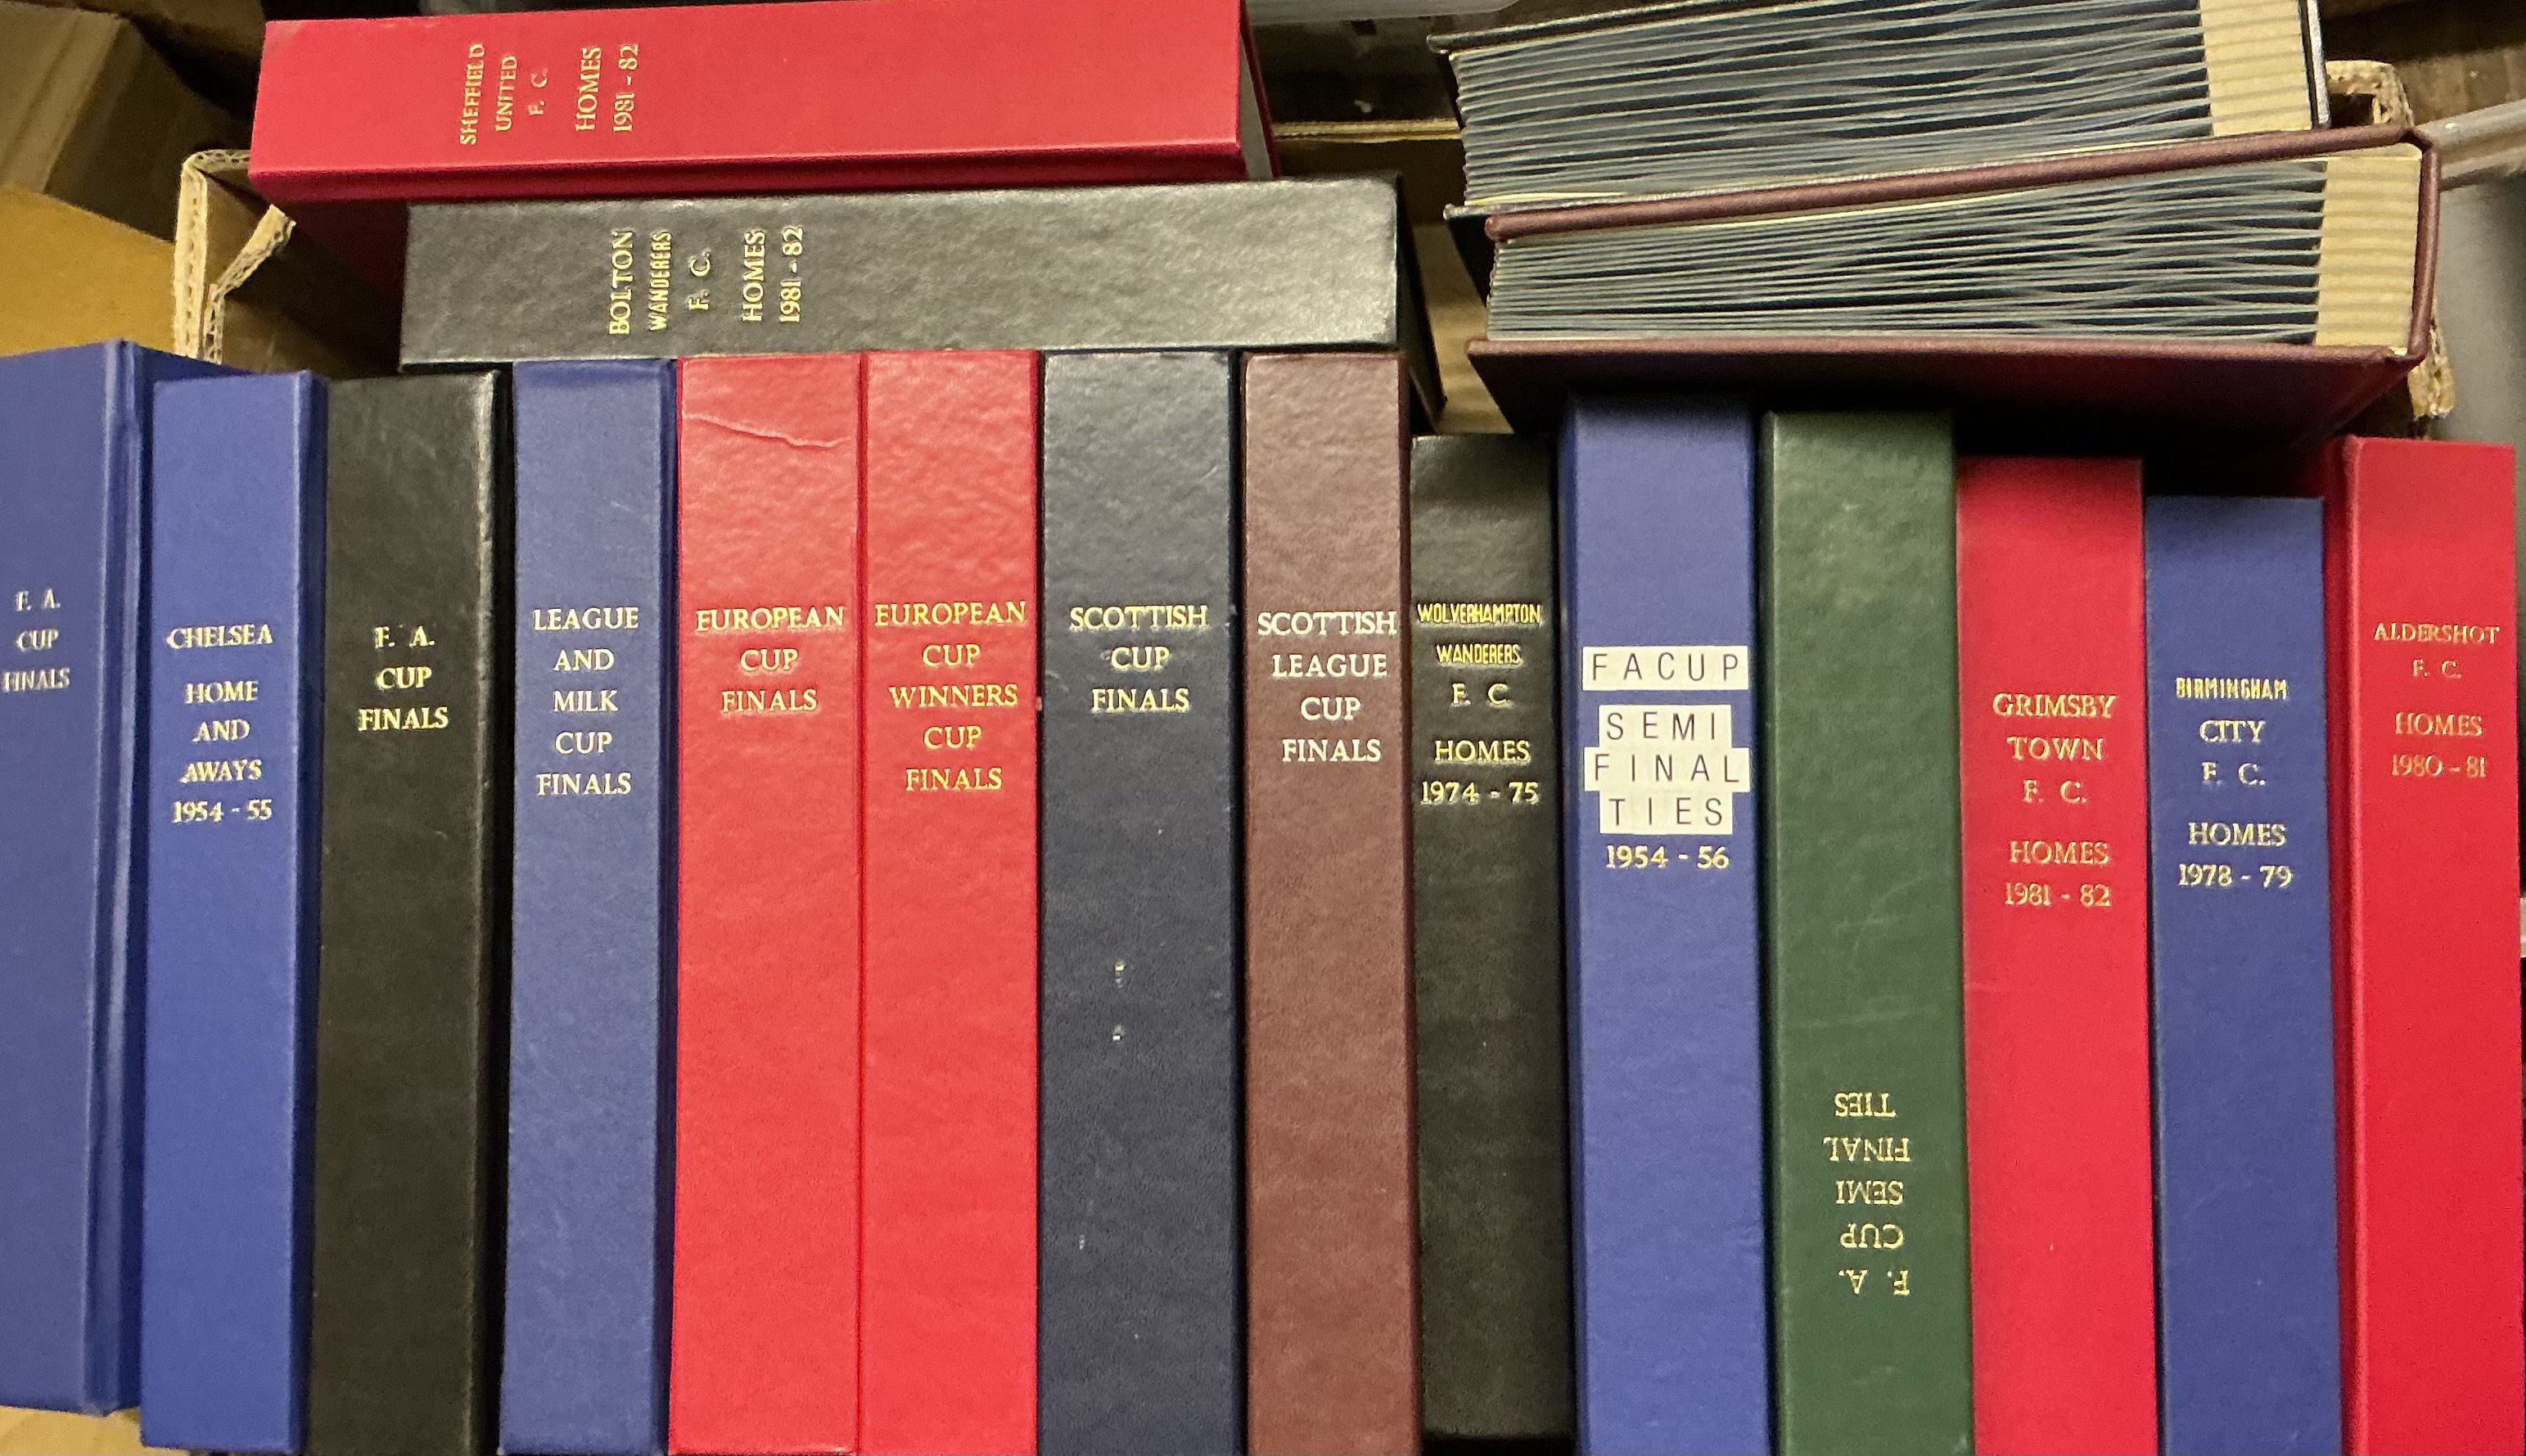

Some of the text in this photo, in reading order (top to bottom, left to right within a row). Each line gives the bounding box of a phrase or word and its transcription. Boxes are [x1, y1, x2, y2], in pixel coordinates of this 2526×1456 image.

[618, 43, 639, 71] 82
[459, 43, 485, 146] SHEFFIELD
[494, 55, 518, 132] UNITED
[575, 46, 602, 132] HOMES
[612, 91, 636, 133] 1981
[780, 226, 804, 257] 82
[608, 228, 635, 336] BOLTON
[648, 230, 673, 331] WANDERERS
[741, 230, 766, 322] HOMES
[778, 279, 802, 324] 1981
[532, 606, 640, 630] LEAGUE
[695, 605, 846, 633] EUROPEAN
[873, 600, 1027, 627] EUROPEAN
[1069, 605, 1209, 631] SCOTTISH
[1257, 611, 1397, 636] SCOTTISH
[1417, 602, 1541, 624] WOLVERHAMPTON
[15, 628, 60, 652] CUP
[166, 623, 274, 651] CHELSEA
[373, 624, 435, 649] F. A.
[2374, 621, 2501, 644] ALDERSHOT
[553, 647, 615, 672] AND
[739, 647, 799, 672] CUP
[921, 642, 981, 667] CUP
[1110, 646, 1171, 671] CUP
[1272, 653, 1389, 678] LEAGUE
[1436, 643, 1522, 665] WANDERERS
[2, 666, 71, 692] FINALS
[375, 665, 433, 690] CUP
[2175, 676, 2289, 700] BIRMINGHAM
[185, 680, 259, 704] HOME
[552, 688, 619, 713] MILK
[721, 687, 818, 713] FINALS
[888, 683, 1019, 710] WINNERS
[1091, 687, 1190, 712] FINALS
[1300, 696, 1362, 721] CUP
[1992, 692, 2117, 719] GRIMSBY
[192, 719, 250, 743] AND
[358, 705, 449, 733] FINALS
[1606, 712, 1717, 741] SEMI
[2199, 719, 2267, 744] CITY
[2394, 711, 2483, 737] HOMES
[554, 730, 613, 755] CUP
[922, 724, 982, 751] CUP
[1282, 738, 1382, 762] FINALS
[2005, 736, 2104, 761] TOWN
[1435, 740, 1531, 763] HOMES
[180, 758, 263, 784] AWAYS
[1595, 754, 1740, 783] FINAL
[2391, 753, 2444, 778] 1980
[2465, 755, 2487, 778] 81
[536, 771, 633, 796] FINALS
[904, 766, 1003, 792] FINALS
[1421, 780, 1480, 805] 1974
[1509, 782, 1539, 805] 75
[172, 799, 223, 823] 1954
[246, 797, 273, 821] 55
[1608, 797, 1724, 827] TIES
[2188, 822, 2288, 847] HOMES
[1606, 845, 1669, 870] 1954
[1696, 845, 1730, 870] 56
[2009, 840, 2110, 865] HOMES
[2177, 863, 2233, 888] 1978
[2259, 864, 2294, 888] 79
[2005, 881, 2051, 908] 1981
[2079, 883, 2112, 908] 82
[1834, 1090, 1897, 1118] TIES
[1823, 1136, 1912, 1163] FINAL
[1835, 1179, 1905, 1206] SEMI
[1839, 1223, 1906, 1250] CUP
